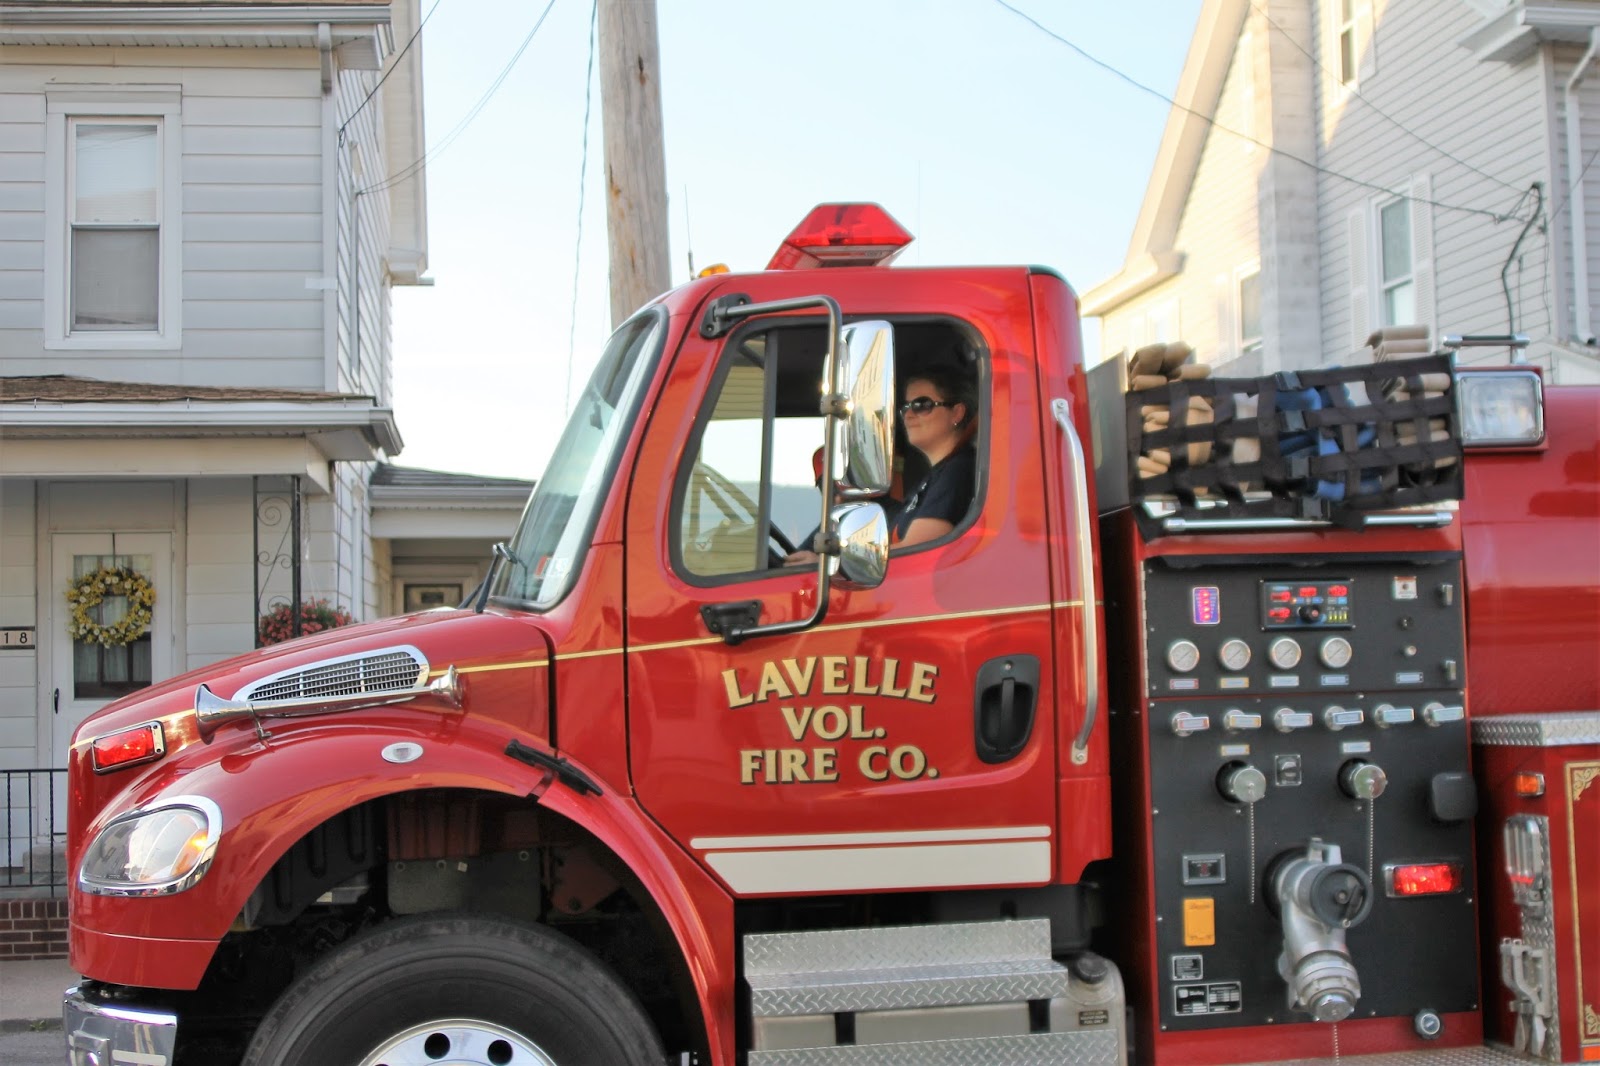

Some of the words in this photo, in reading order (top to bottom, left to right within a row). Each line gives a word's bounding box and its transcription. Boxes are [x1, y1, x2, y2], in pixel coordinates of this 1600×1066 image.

[721, 656, 939, 708] LAVELLE
[781, 705, 888, 742] VOL.
[740, 748, 840, 785] FIRE
[858, 744, 940, 781] CO.
